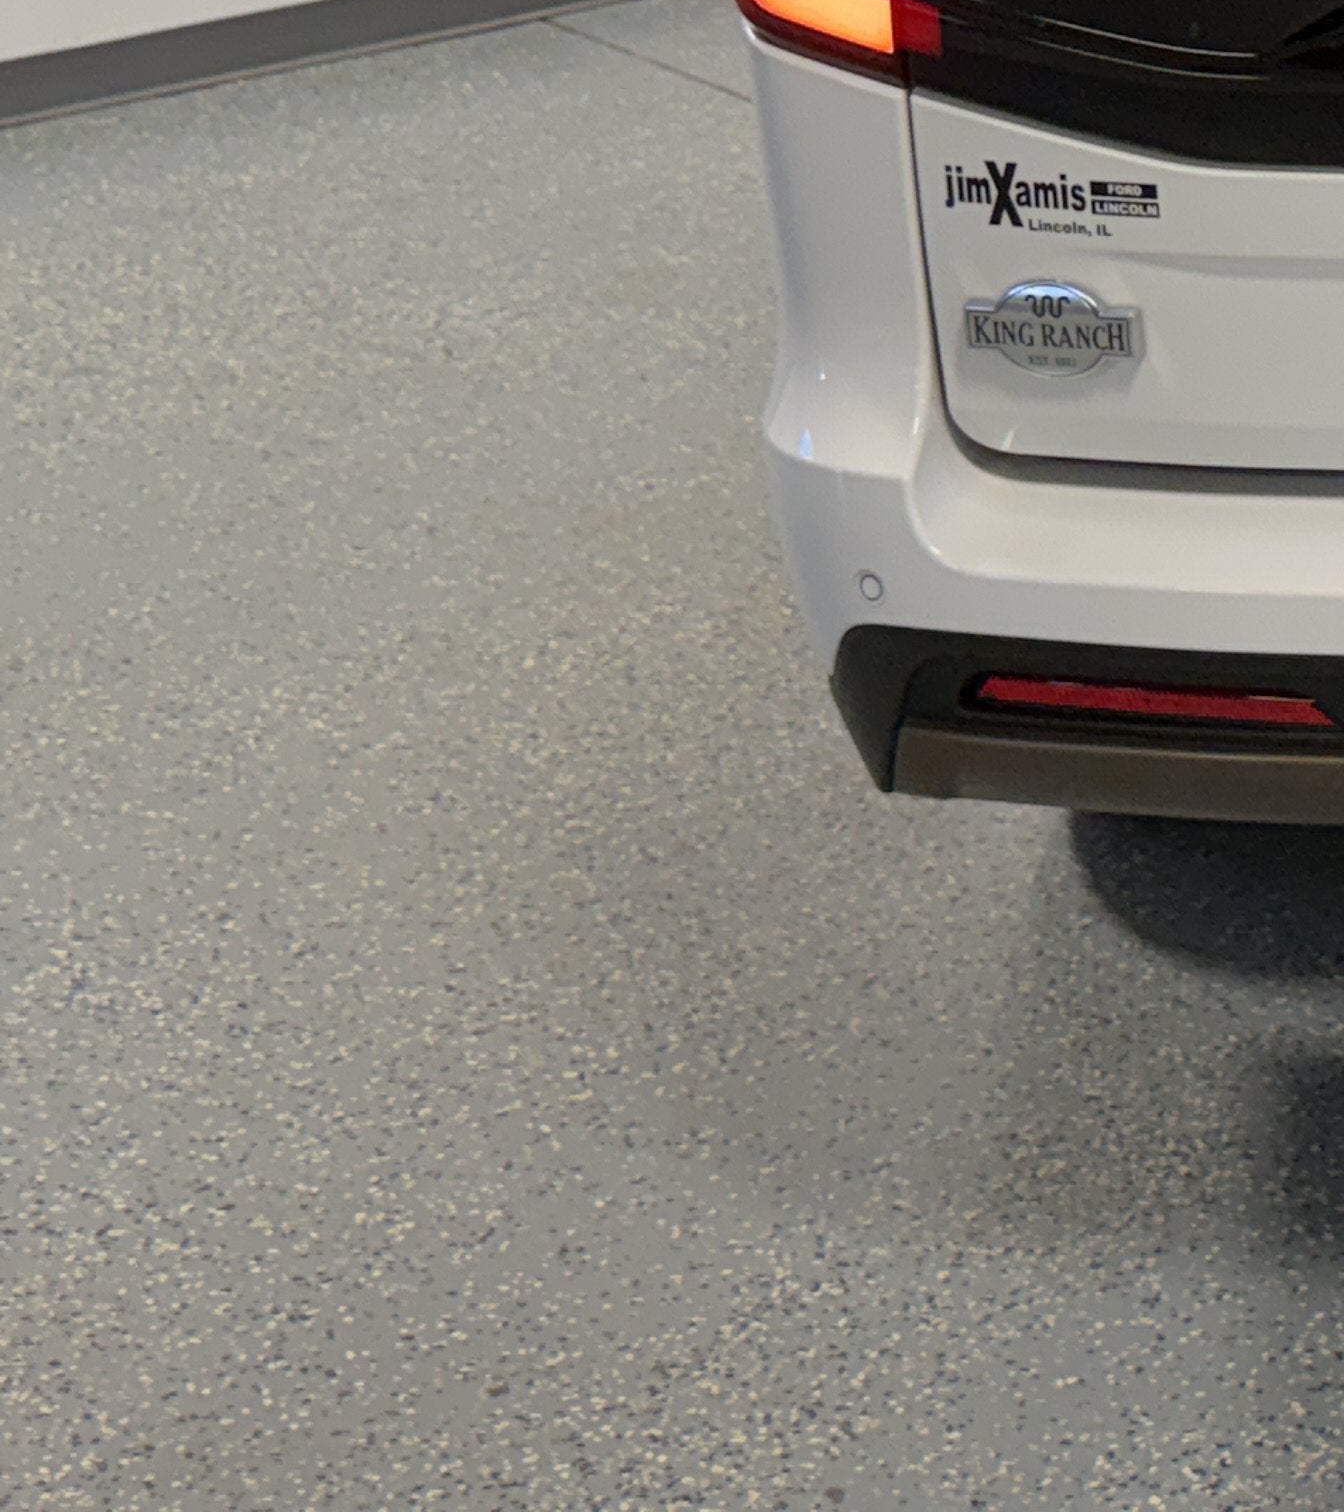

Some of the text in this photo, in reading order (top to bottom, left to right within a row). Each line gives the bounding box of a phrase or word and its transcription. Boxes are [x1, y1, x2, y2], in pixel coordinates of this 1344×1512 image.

[1107, 182, 1143, 197] FORD
[1094, 201, 1159, 216] LINCOLN
[1028, 218, 1113, 237] Lincoln, IL
[973, 314, 1127, 352] KING RANCH
